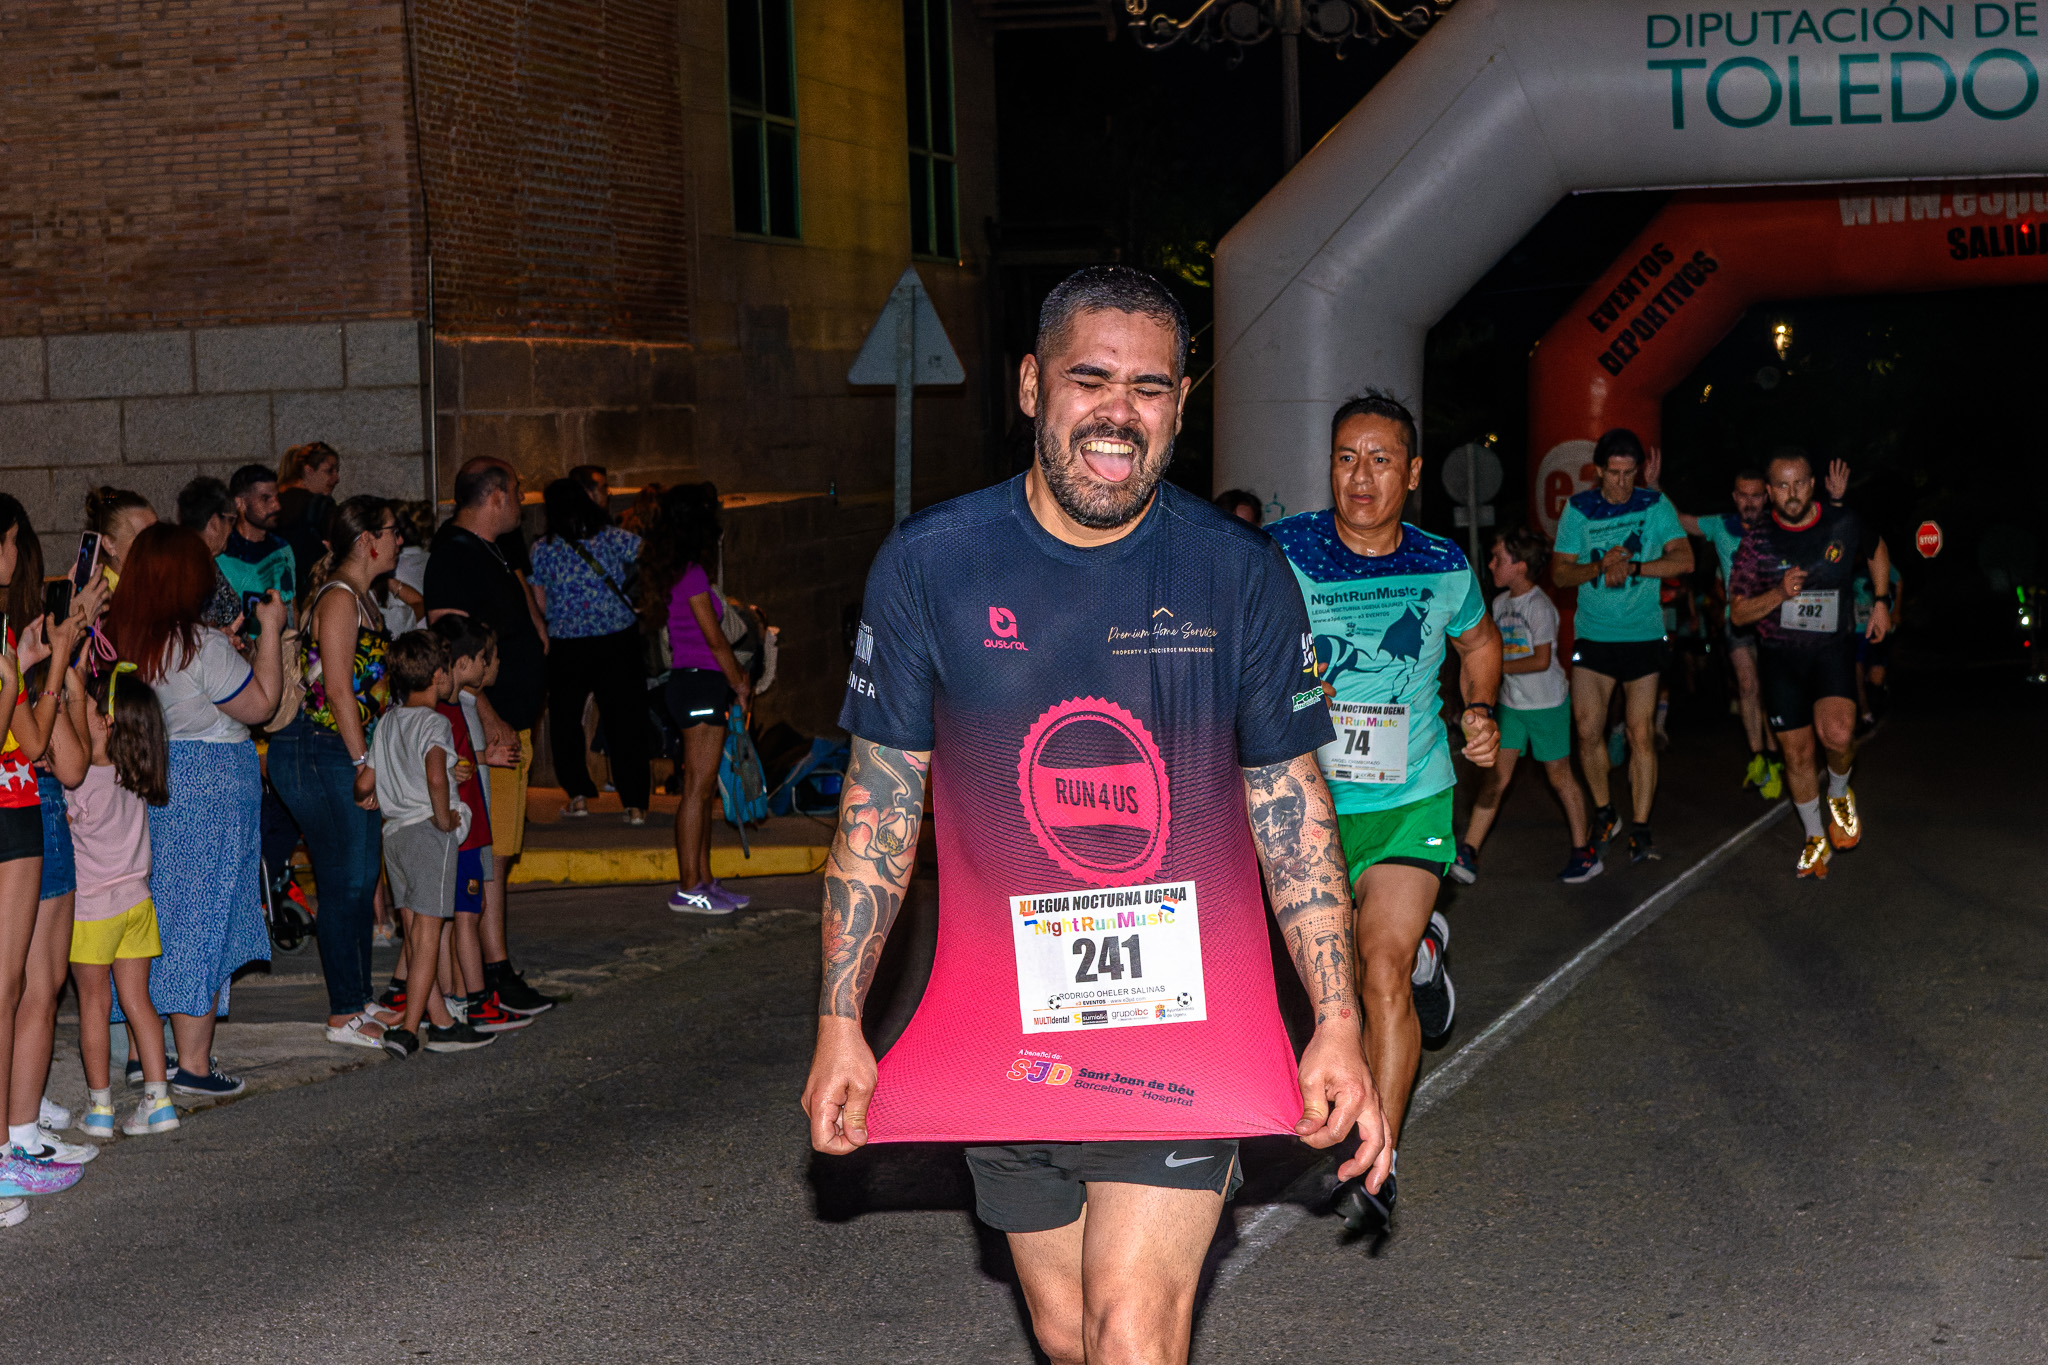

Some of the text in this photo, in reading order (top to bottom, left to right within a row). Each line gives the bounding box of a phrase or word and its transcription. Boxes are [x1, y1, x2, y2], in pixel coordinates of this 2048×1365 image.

[1647, 0, 2038, 48] DIPUTACIÓN DE
[1647, 48, 2039, 129] TOLEDO
[1588, 243, 1674, 332] EVENTOS
[1598, 251, 1718, 376] DEPORTIVOS
[1919, 534, 1938, 545] STOP
[1107, 626, 1150, 643] Premium
[1152, 622, 1179, 640] Home
[1341, 704, 1382, 715] NOCTURNA
[1383, 706, 1406, 715] UGENA
[1344, 729, 1371, 756] 74
[1055, 777, 1139, 814] RUN4US
[1032, 898, 1070, 914] LEGUA
[1072, 890, 1142, 911] NOCTURNA
[1145, 886, 1187, 904] UGENA
[1072, 934, 1143, 984] 241
[1059, 985, 1166, 1000] RODRIGO OHELER SALINAS
[1033, 1015, 1070, 1025] MULTIdental
[1111, 1008, 1149, 1020] grupoibc
[1006, 1058, 1073, 1086] SJD
[1078, 1067, 1195, 1097] Sant Joan de Déu
[1074, 1079, 1194, 1107] Barcelona Hospital
